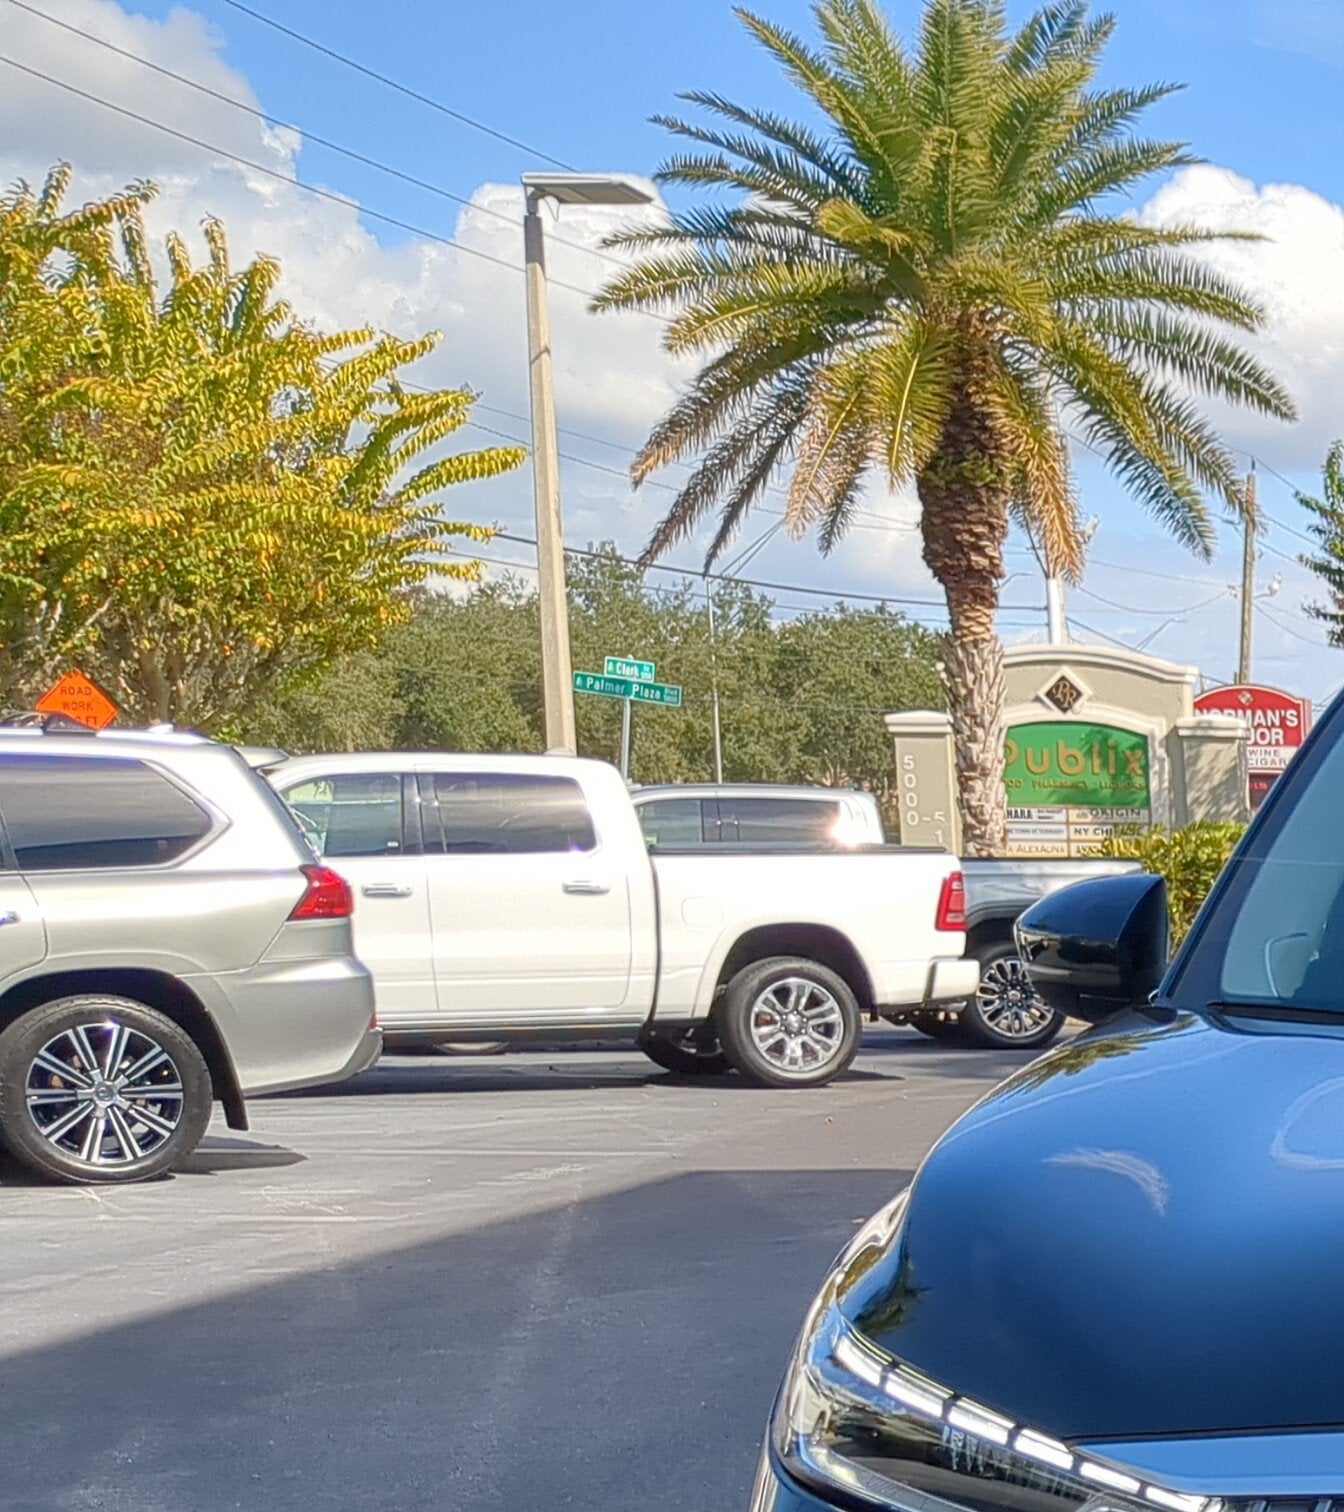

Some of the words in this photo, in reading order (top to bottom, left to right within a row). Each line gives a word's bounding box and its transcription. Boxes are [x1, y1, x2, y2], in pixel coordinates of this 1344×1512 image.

[616, 662, 640, 679] Clark
[60, 686, 92, 695] ROAD
[586, 677, 625, 694] Palmer
[632, 684, 661, 700] Plaza
[62, 701, 93, 711] WORK
[1004, 737, 1145, 776] Publix
[1247, 749, 1280, 757] WINE
[1247, 758, 1287, 767] CIGAR
[1074, 827, 1089, 836] NY
